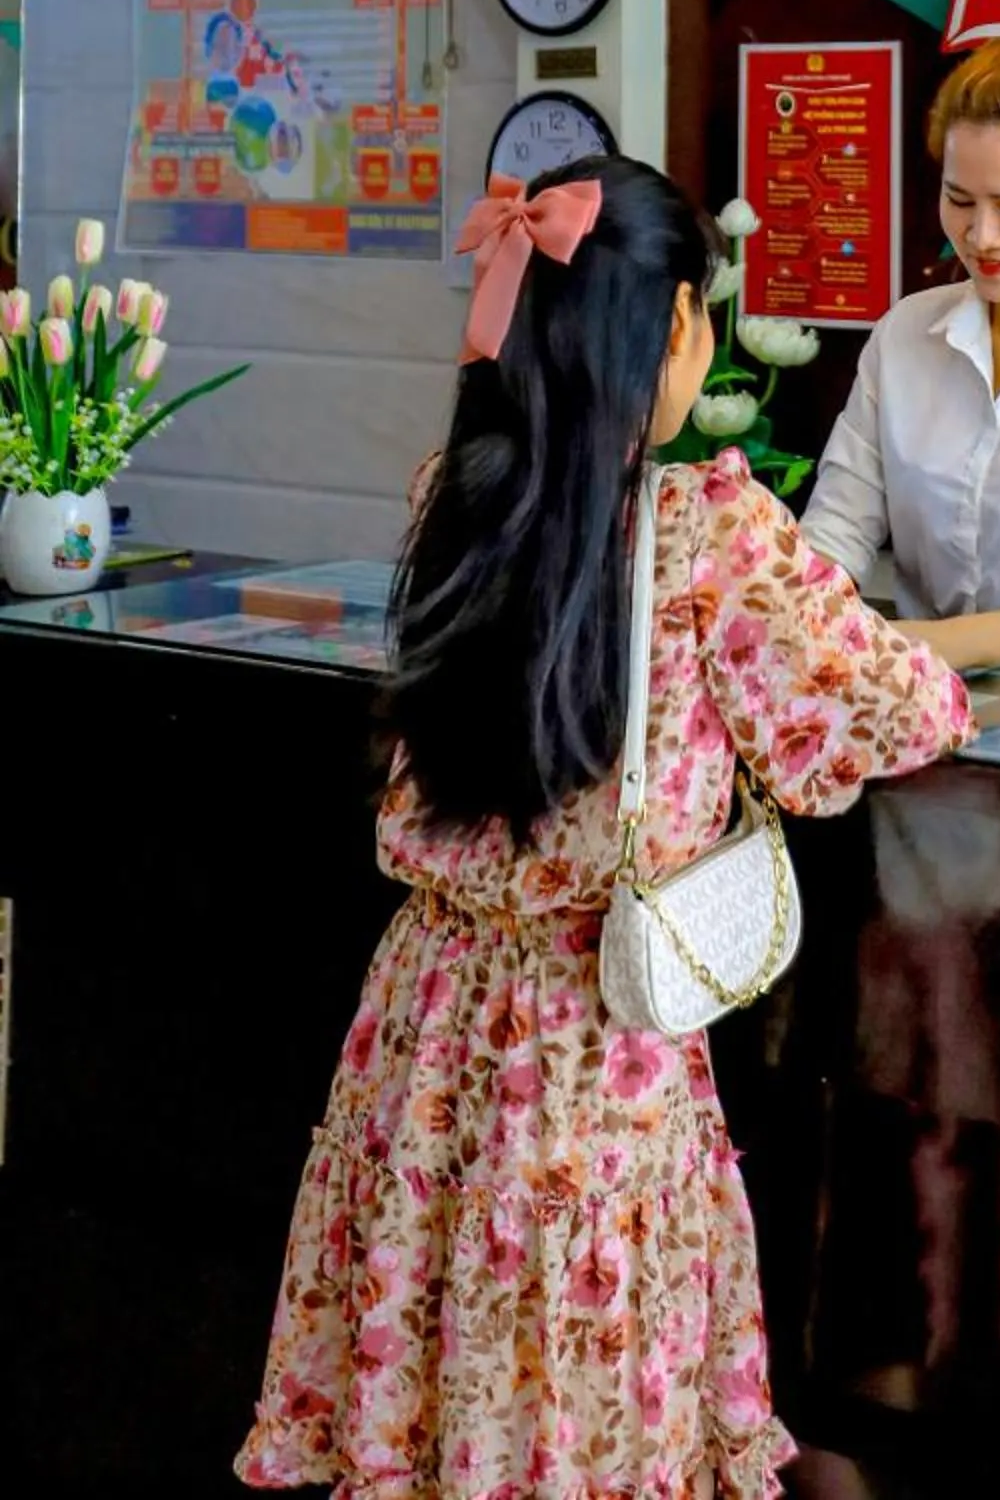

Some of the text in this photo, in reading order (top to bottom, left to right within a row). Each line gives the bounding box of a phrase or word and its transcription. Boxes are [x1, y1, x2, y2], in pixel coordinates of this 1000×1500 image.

[530, 121, 541, 139] 11
[548, 108, 566, 132] 12
[514, 142, 529, 162] 10
